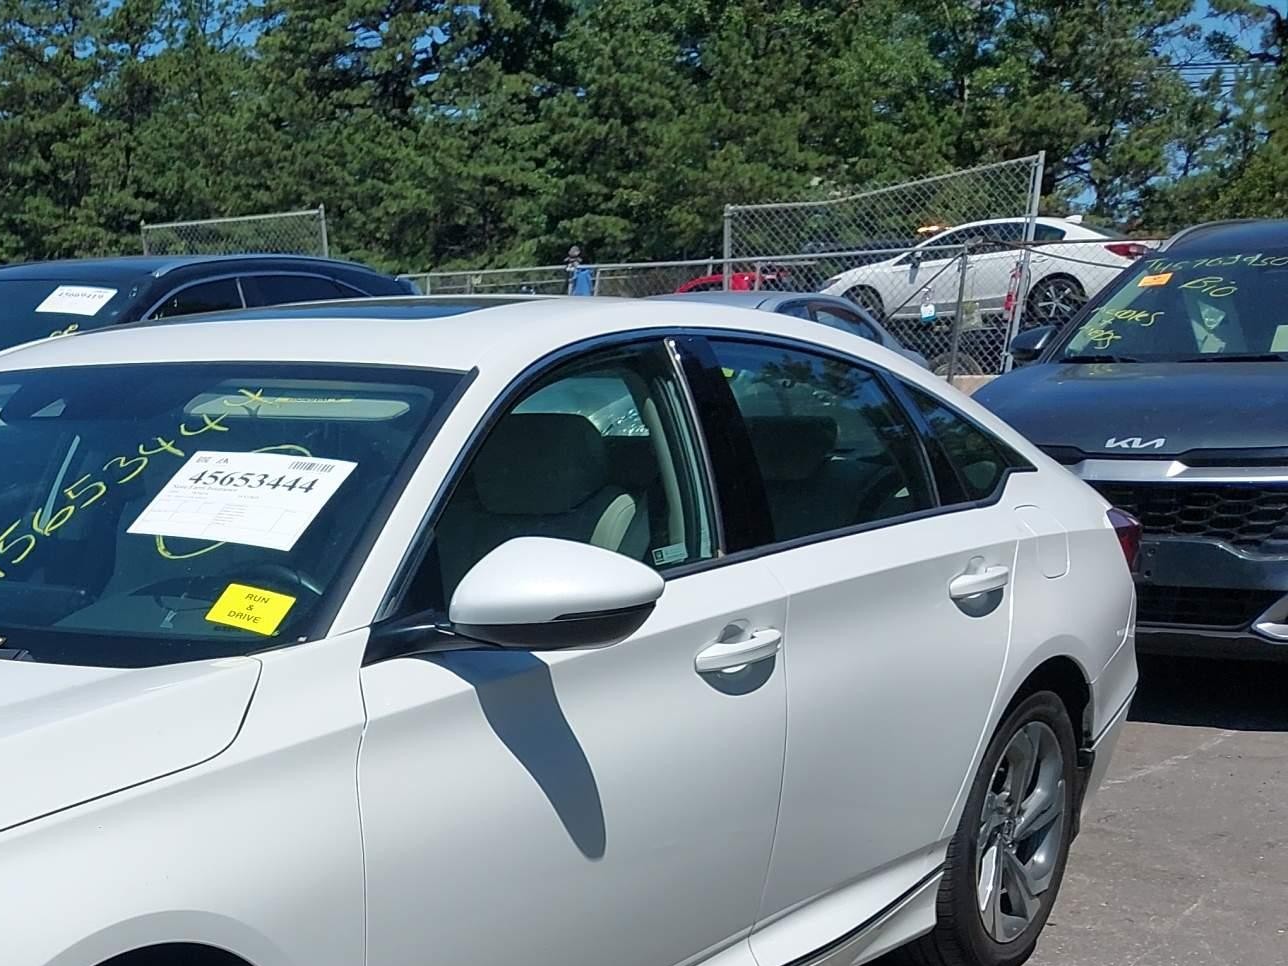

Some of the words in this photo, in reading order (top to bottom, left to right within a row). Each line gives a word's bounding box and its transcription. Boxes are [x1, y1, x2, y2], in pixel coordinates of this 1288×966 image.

[1105, 437, 1167, 448] KIA
[188, 470, 319, 493] 45653444
[245, 593, 271, 604] RUN
[227, 610, 262, 624] DRIVE
